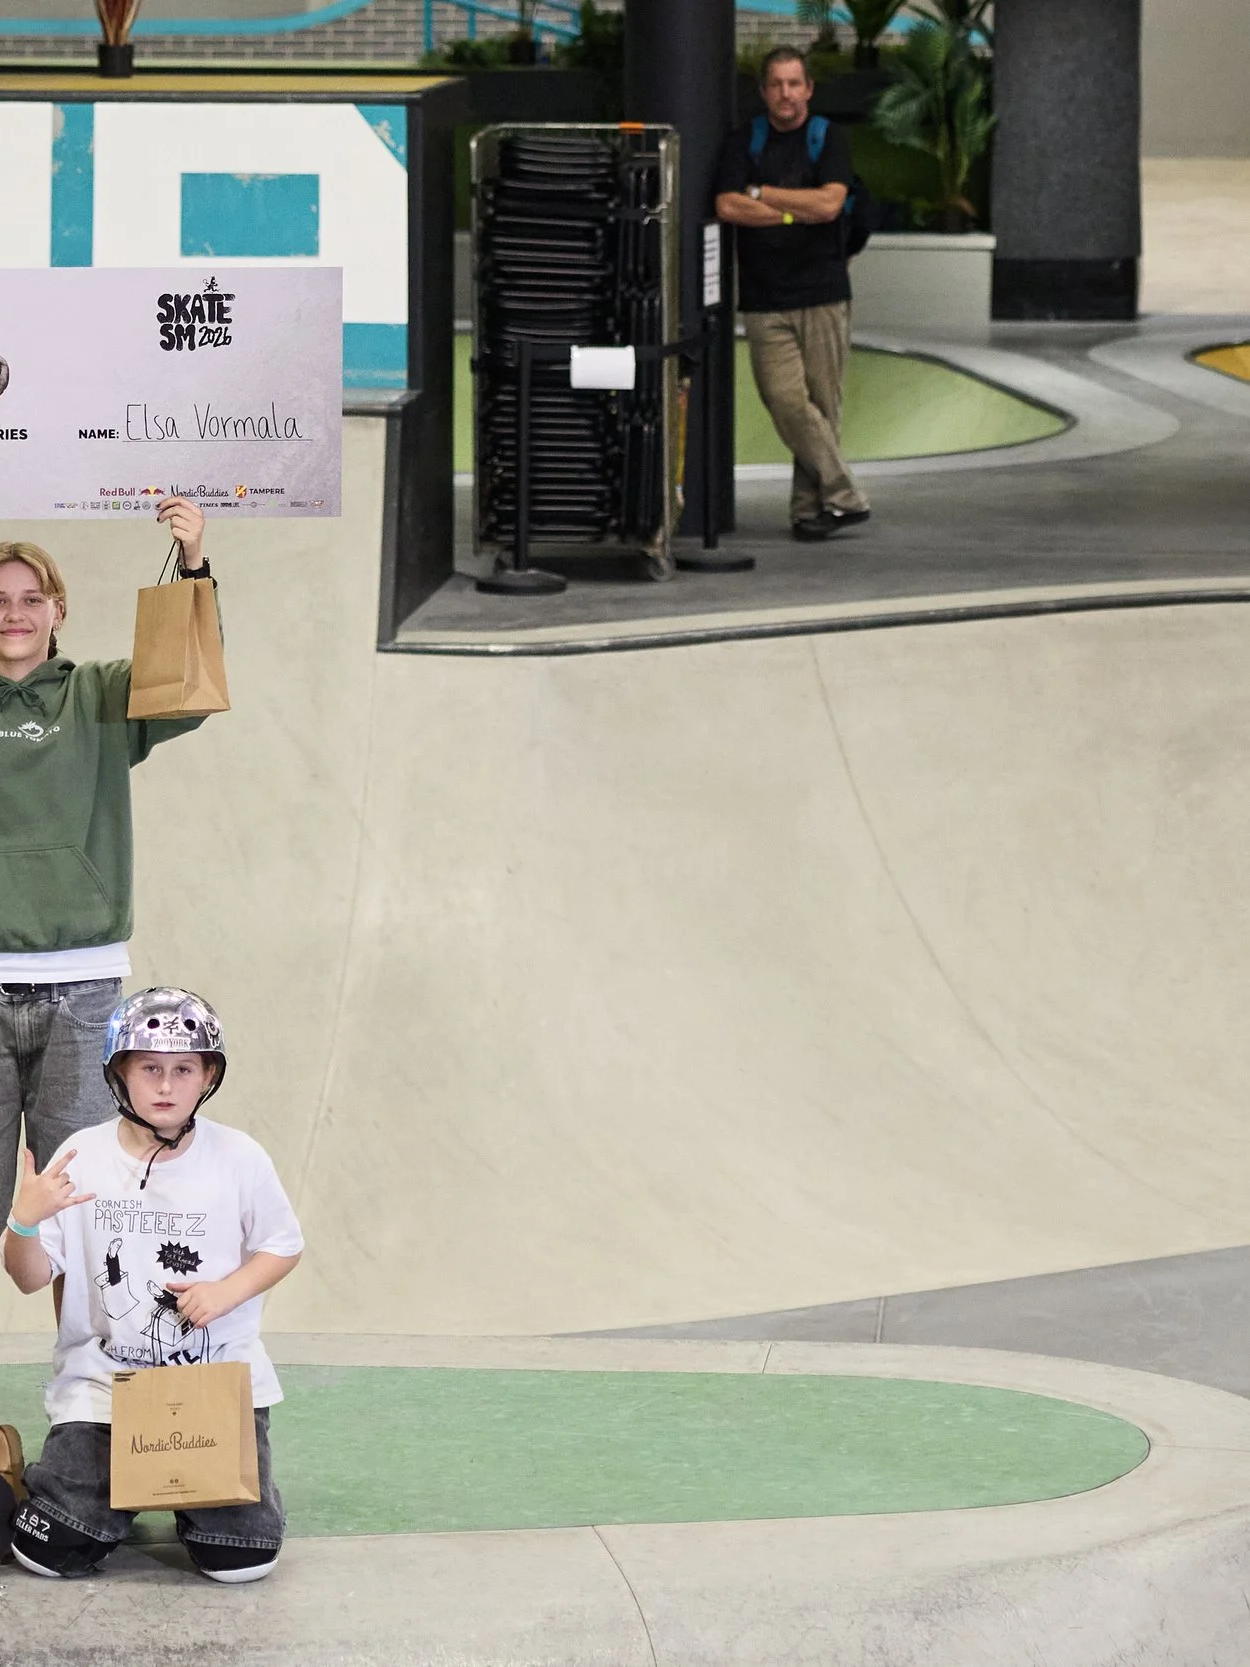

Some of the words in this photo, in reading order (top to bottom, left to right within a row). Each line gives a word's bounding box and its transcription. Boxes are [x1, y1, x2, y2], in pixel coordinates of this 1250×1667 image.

[157, 293, 236, 324] SKATE
[159, 324, 195, 351] SM
[198, 325, 232, 348] 2026
[126, 403, 180, 440] Elsa
[195, 402, 303, 441] Vormala
[78, 429, 120, 441] NAME:
[100, 487, 117, 497] Red
[118, 487, 136, 497] Bull
[249, 487, 285, 495] TAMPERE
[94, 1199, 143, 1209] CORNISH
[94, 1208, 207, 1236] PASTEEEZ
[121, 1345, 152, 1358] FROM
[20, 1508, 50, 1532] 187
[32, 1529, 49, 1542] PADS
